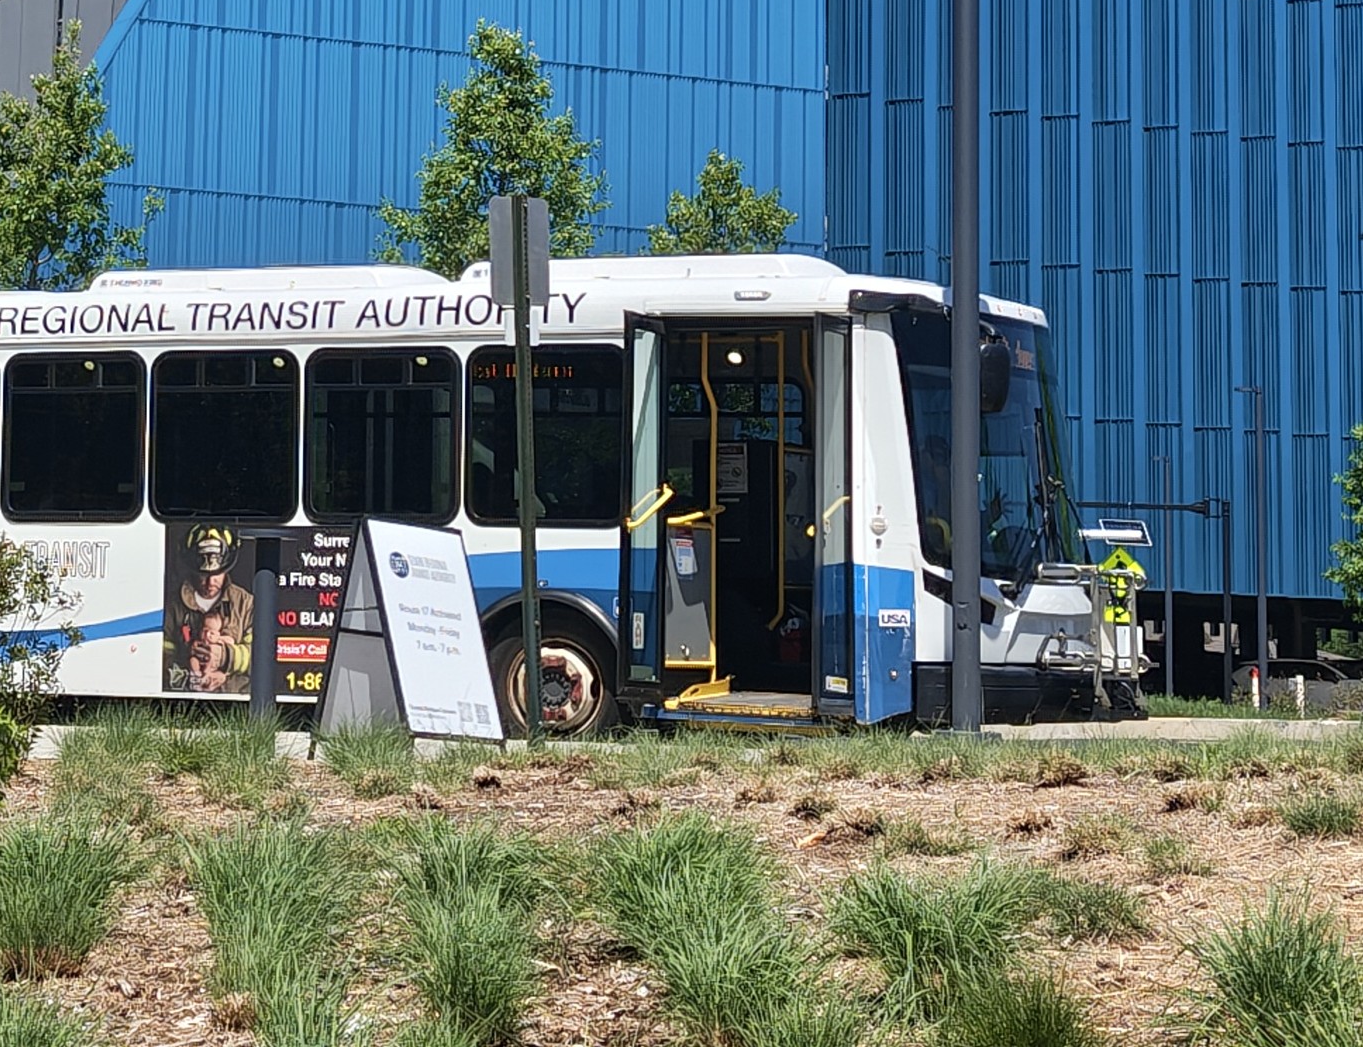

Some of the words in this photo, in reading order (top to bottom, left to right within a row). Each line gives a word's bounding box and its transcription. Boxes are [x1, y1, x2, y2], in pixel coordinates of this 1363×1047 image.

[186, 299, 346, 333] TRANSIT
[354, 292, 588, 328] AUTHOTY
[301, 553, 333, 567] Your
[290, 572, 316, 587] Fire
[881, 613, 908, 625] USA
